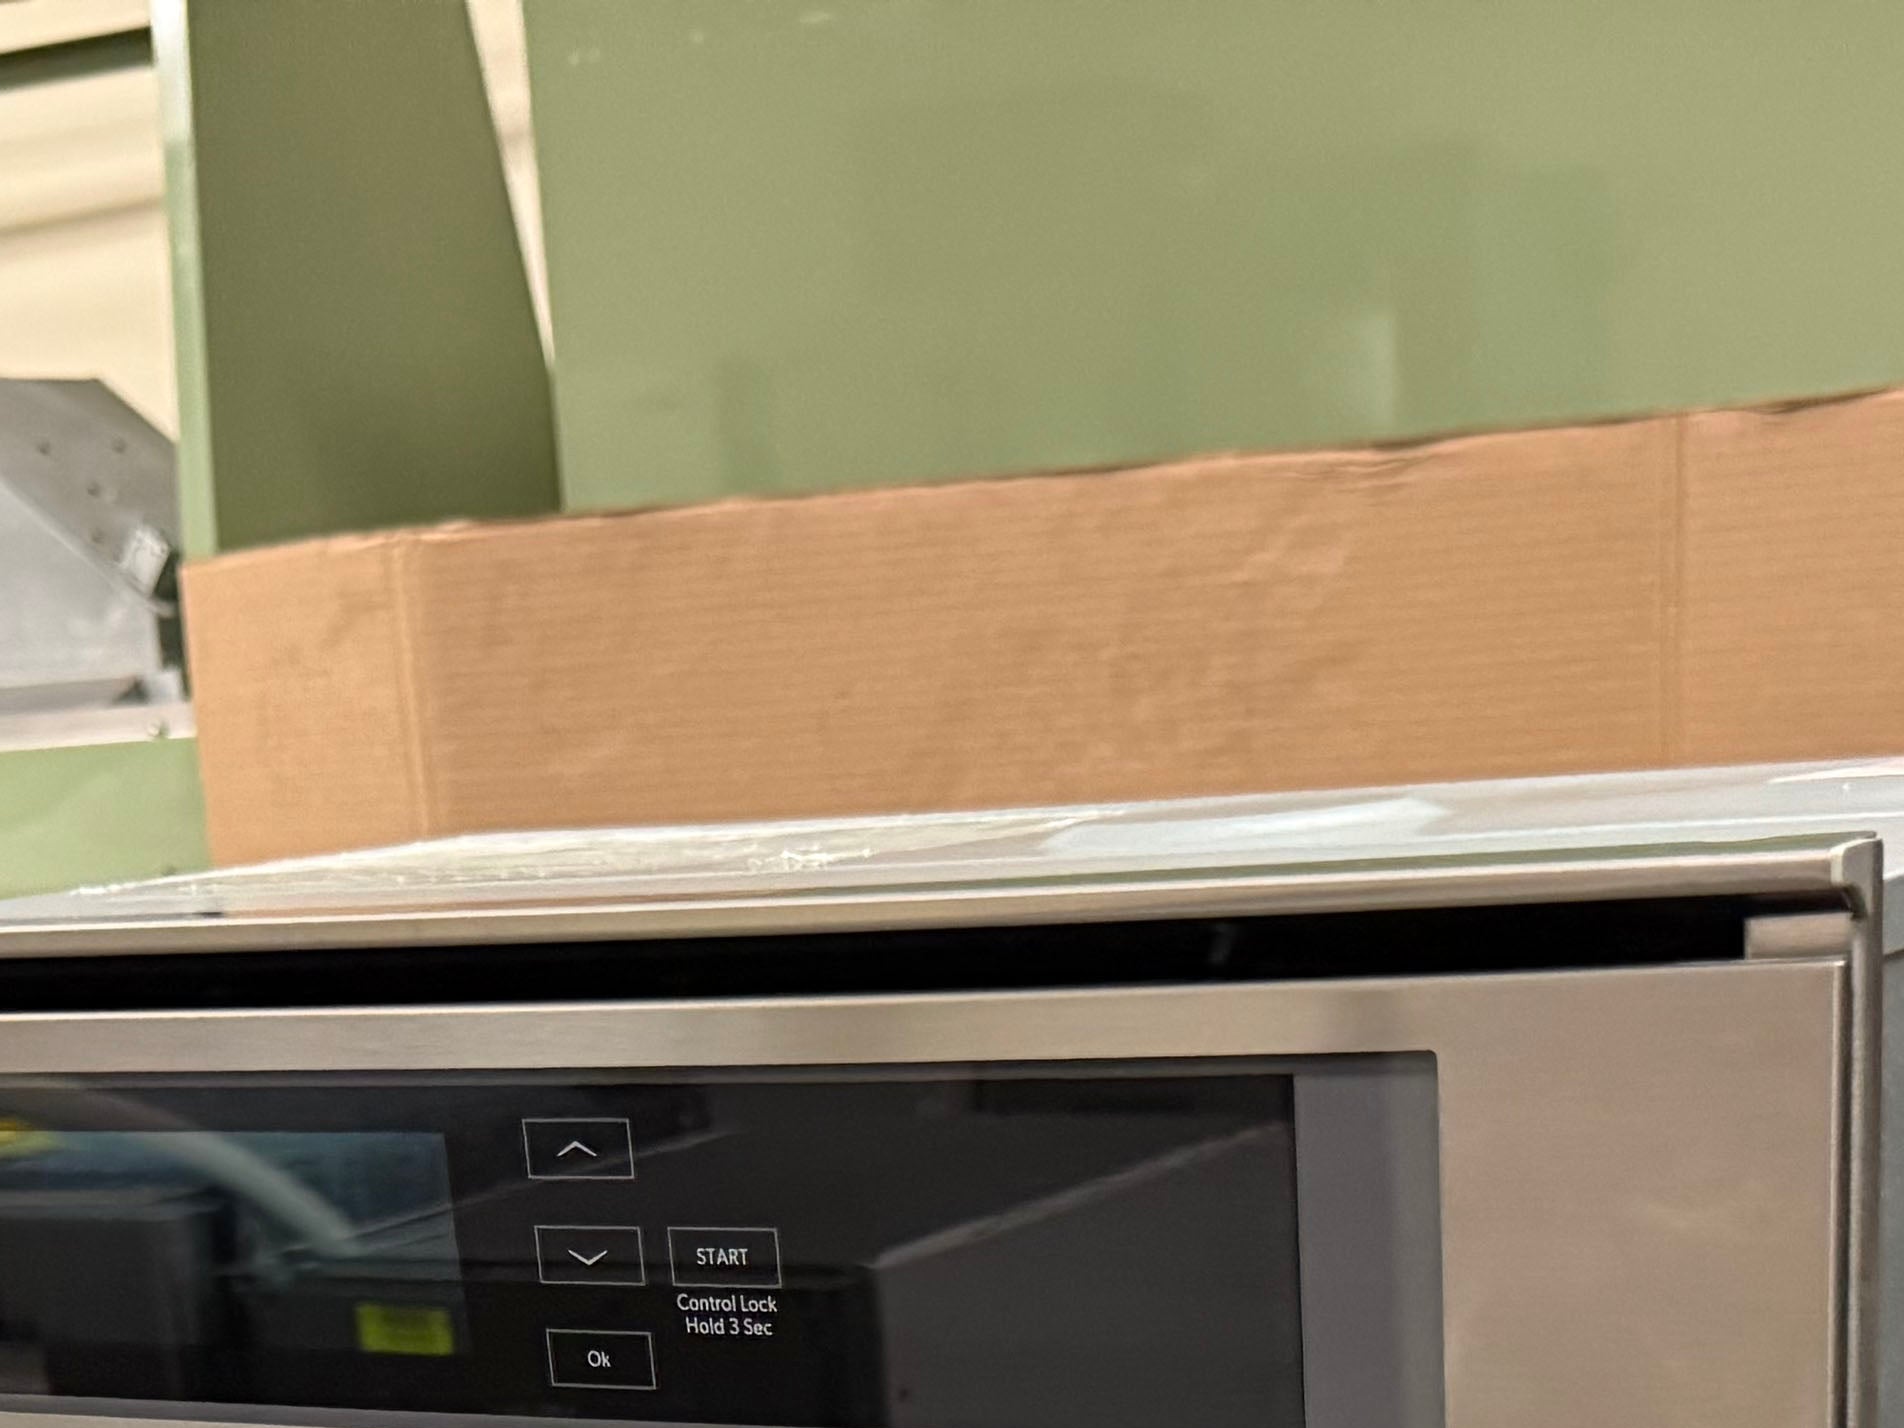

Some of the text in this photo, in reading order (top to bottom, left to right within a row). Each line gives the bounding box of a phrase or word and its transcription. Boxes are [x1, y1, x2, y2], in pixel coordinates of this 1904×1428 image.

[696, 1248, 749, 1266] START
[676, 1293, 778, 1312] Control Lock
[685, 1317, 774, 1336] Hold 3 Sec
[587, 1350, 611, 1368] Ok
